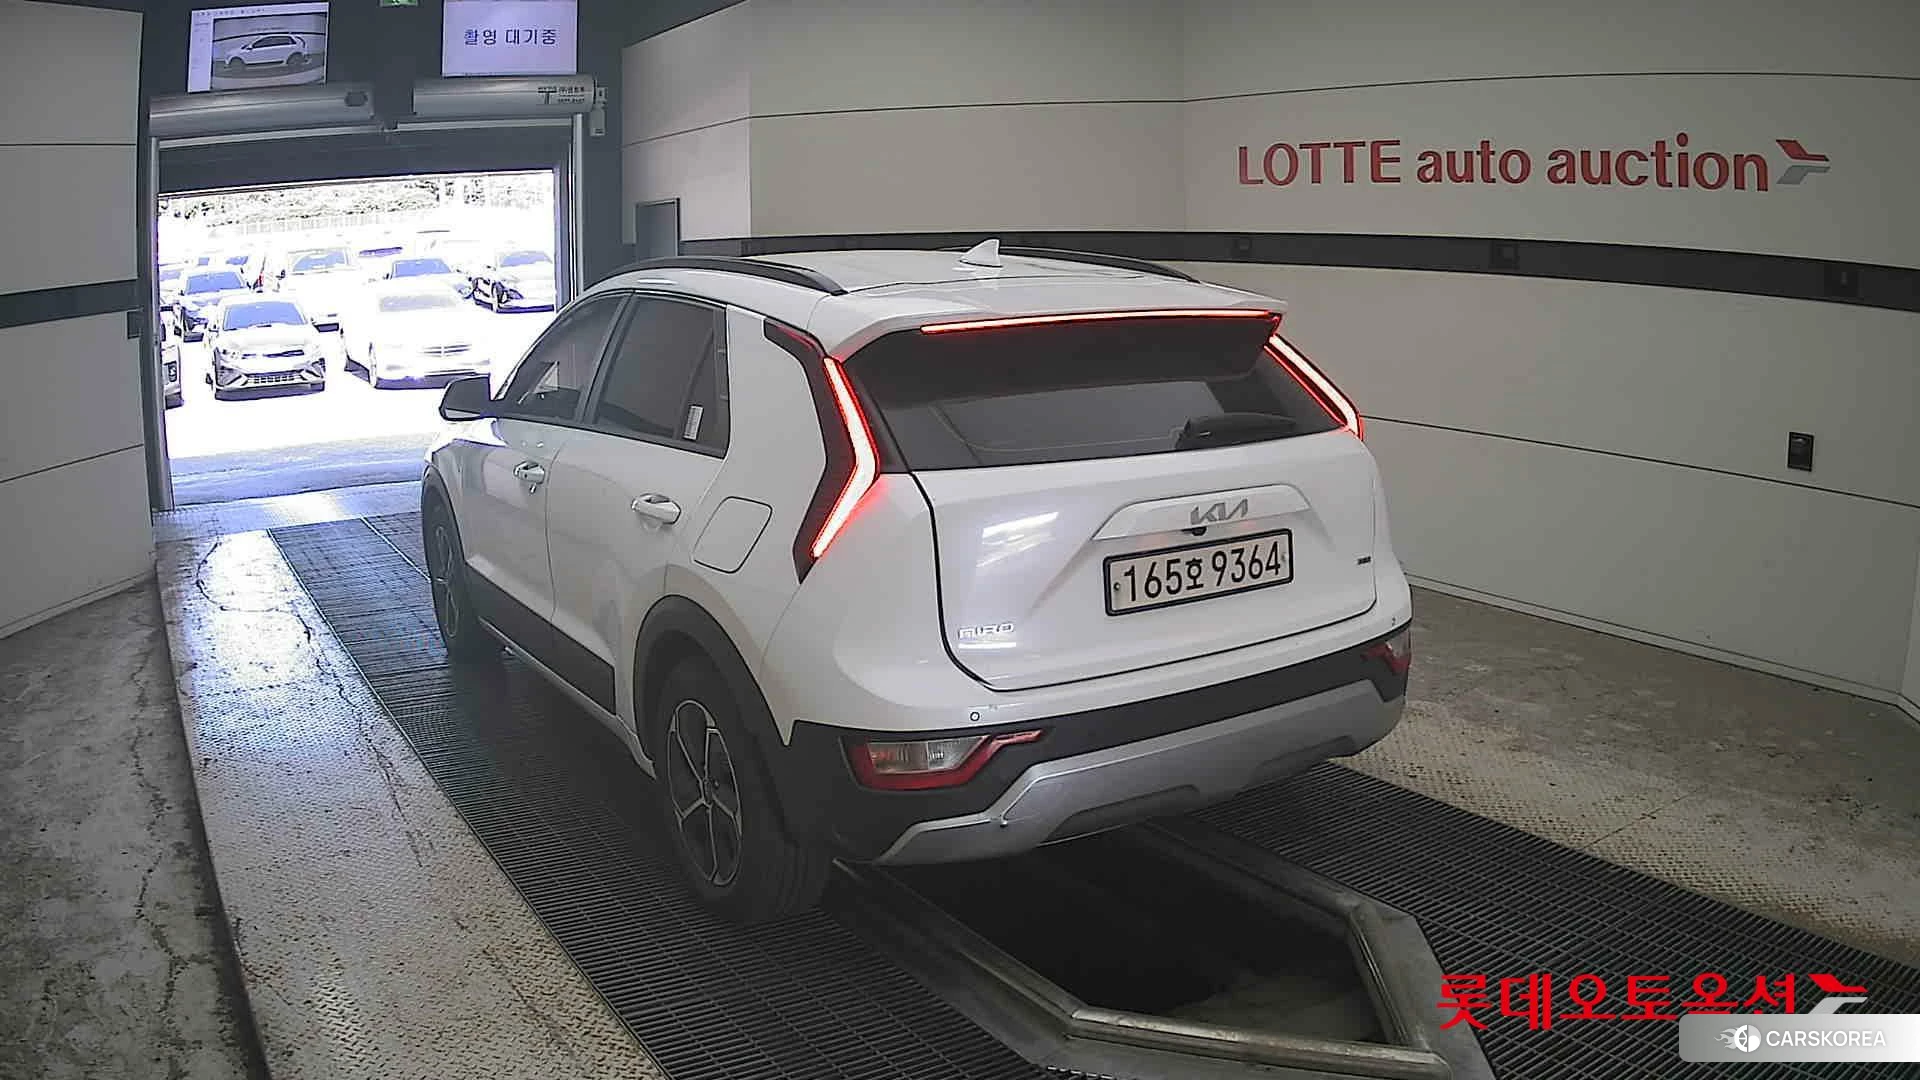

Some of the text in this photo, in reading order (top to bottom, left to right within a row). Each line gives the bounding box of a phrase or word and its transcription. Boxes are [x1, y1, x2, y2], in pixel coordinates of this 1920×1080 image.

[464, 29, 557, 46] 촬영 대기중
[1238, 132, 1769, 192] LOTTE auto auction
[1190, 498, 1248, 525] KIA
[1123, 541, 1281, 602] 165호 9364
